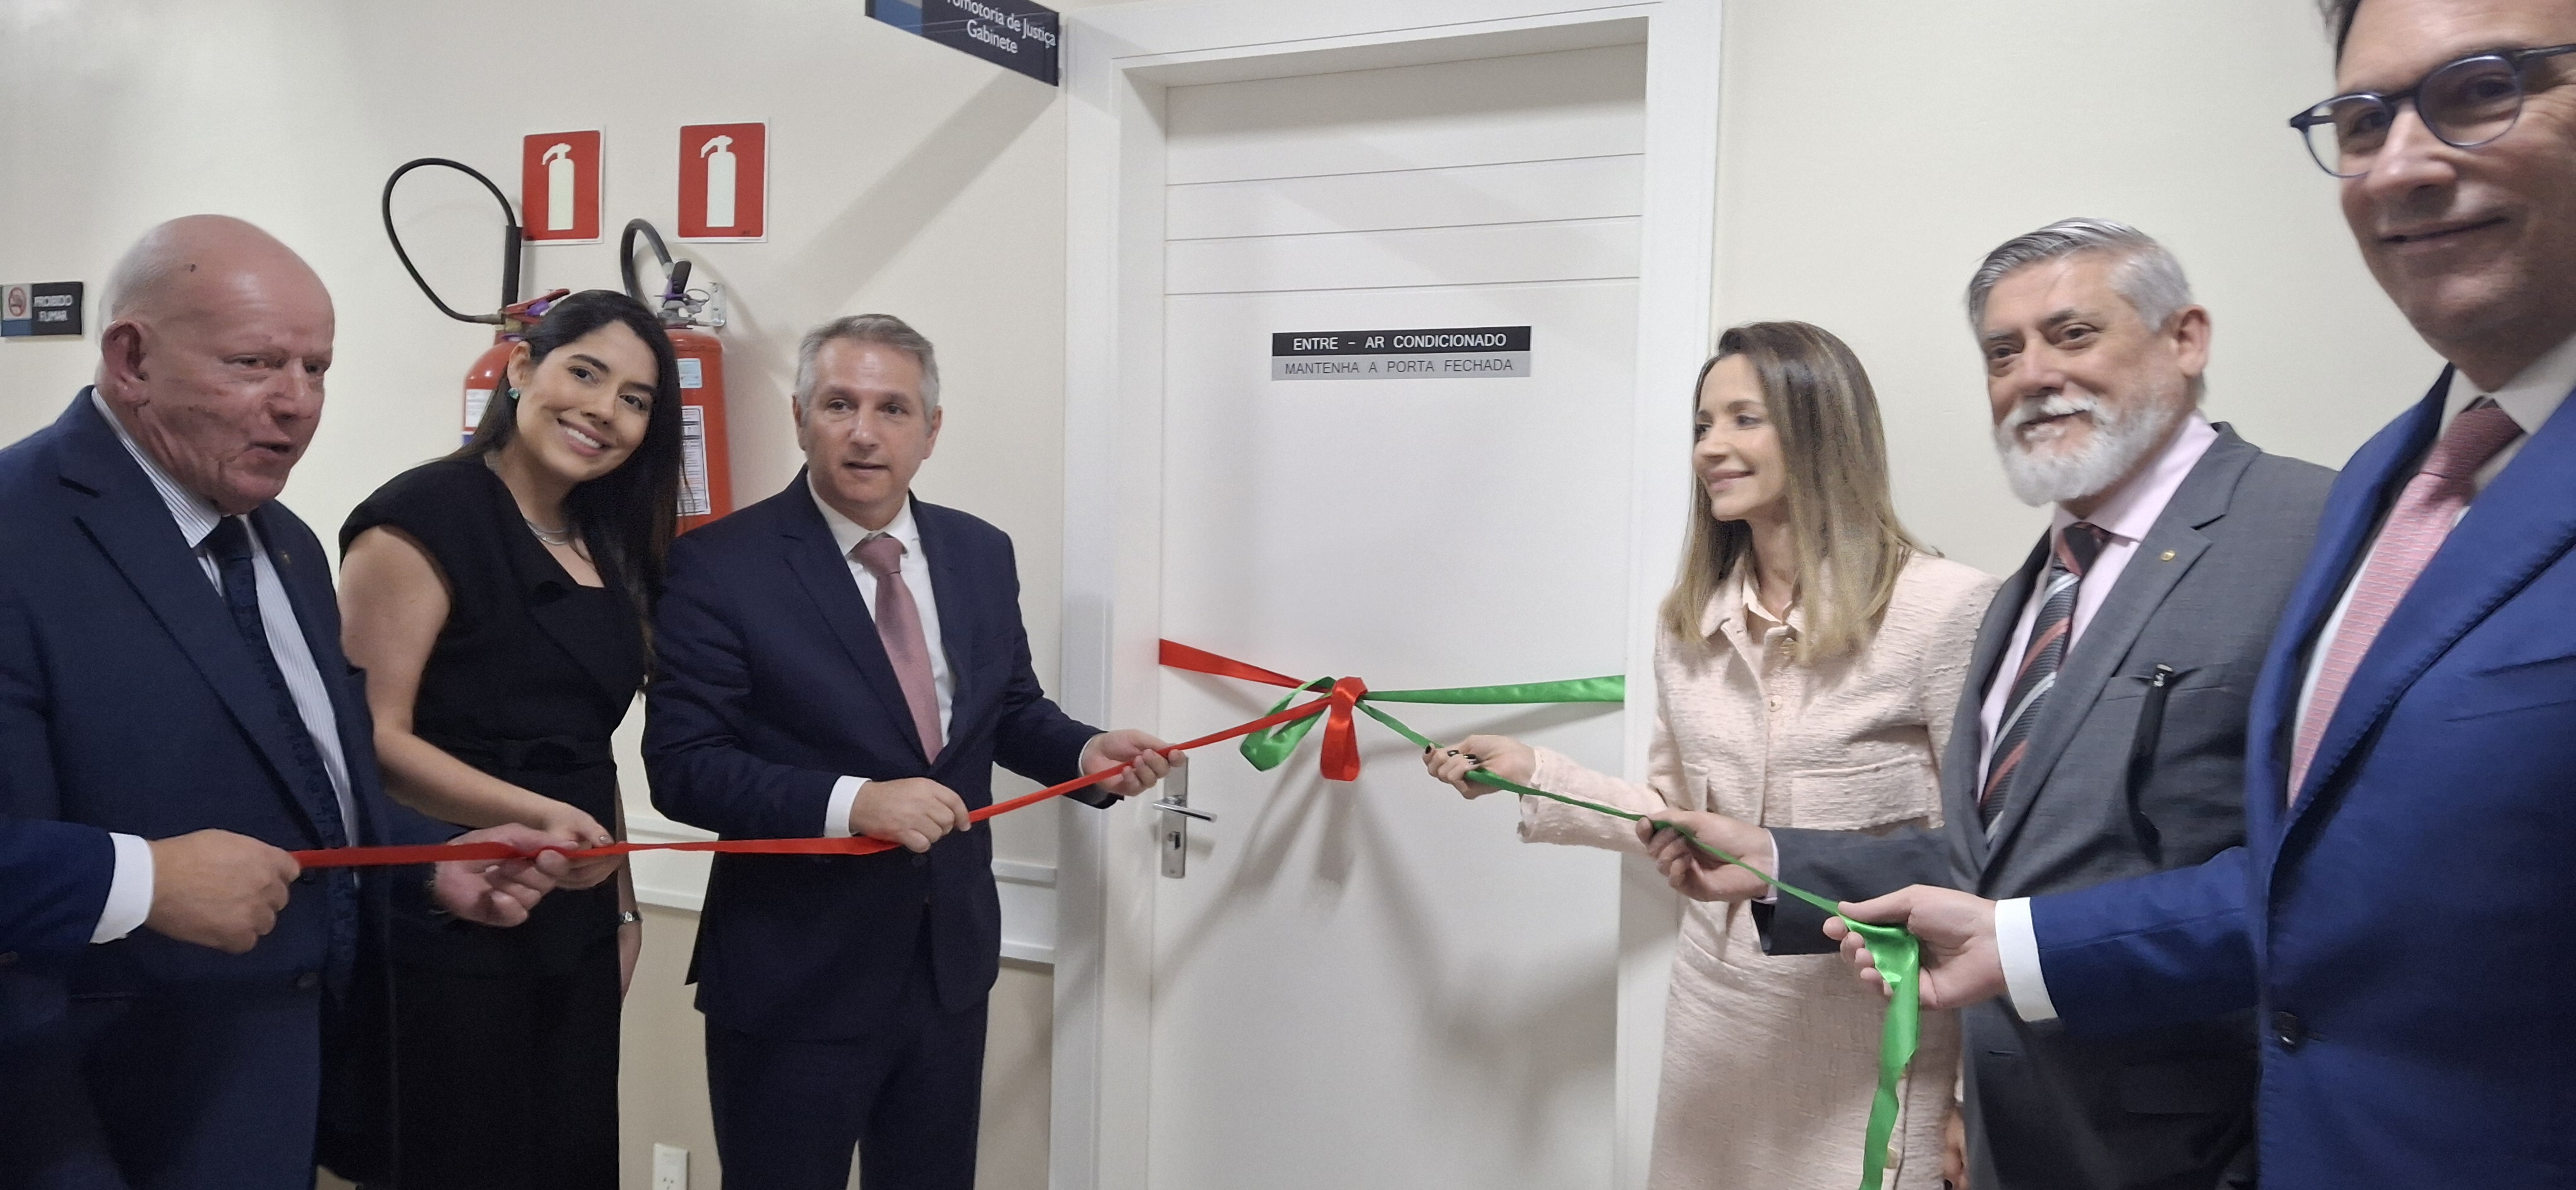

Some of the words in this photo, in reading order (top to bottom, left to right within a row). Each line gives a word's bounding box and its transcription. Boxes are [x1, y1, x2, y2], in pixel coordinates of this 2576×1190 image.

[947, 0, 1004, 25] omotoria
[1006, 13, 1021, 32] de
[1021, 18, 1056, 49] Justiça
[967, 19, 1018, 54] Gabinete
[1293, 337, 1339, 351] ENTRE
[1364, 336, 1385, 348] AR
[1393, 334, 1506, 348] CONDICIONADO
[1285, 361, 1359, 374] MANTENHA
[1368, 361, 1378, 373] A
[1386, 360, 1435, 373] PORTA
[1444, 359, 1513, 372] FECHADA
